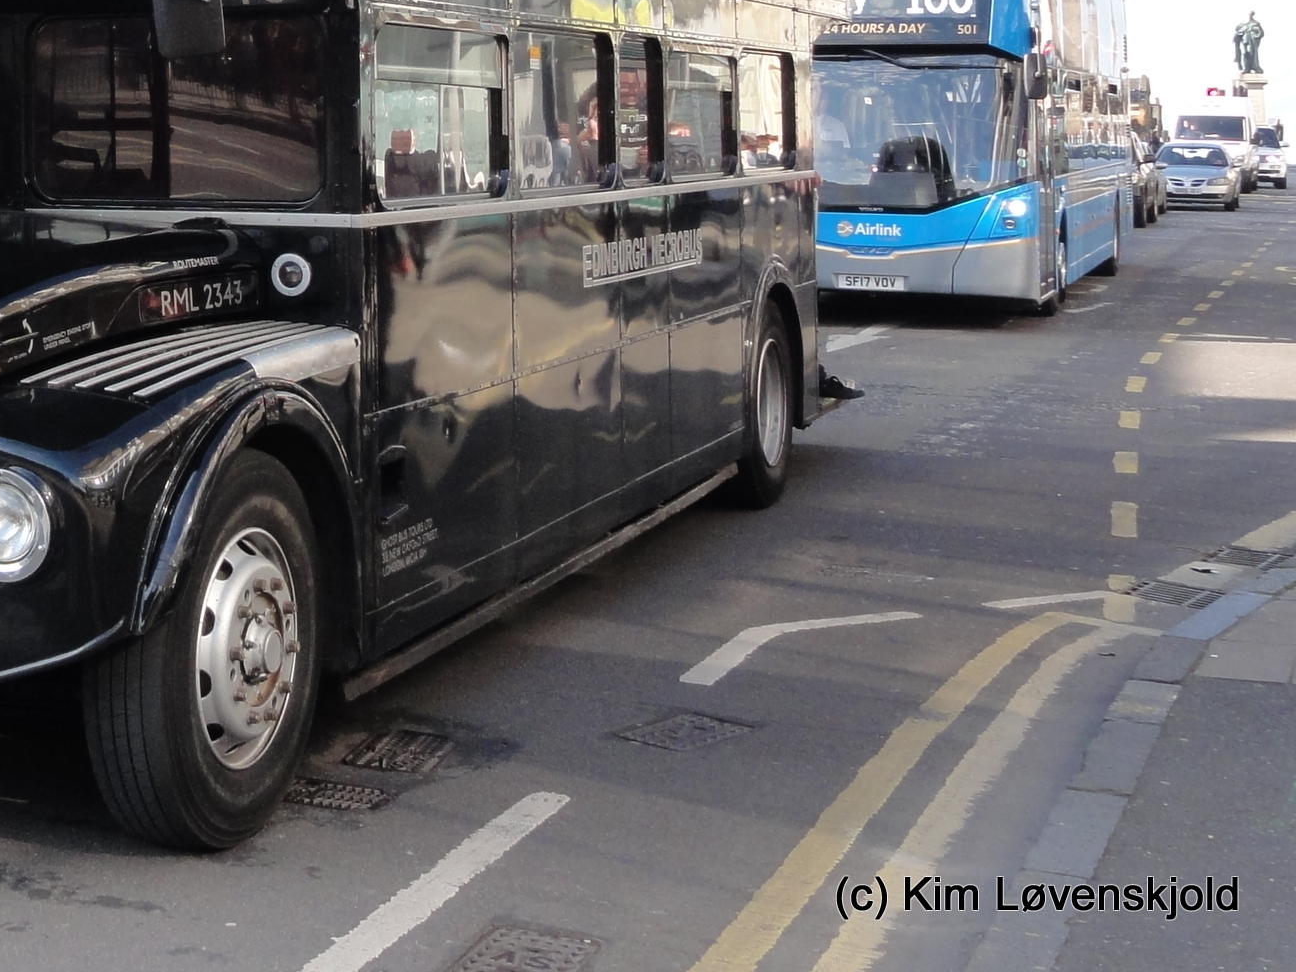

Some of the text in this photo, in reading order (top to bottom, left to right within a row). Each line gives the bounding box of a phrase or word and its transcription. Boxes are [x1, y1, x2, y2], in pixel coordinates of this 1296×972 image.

[841, 24, 886, 34] HOURS
[886, 23, 896, 34] A
[899, 23, 926, 34] DAY
[957, 24, 977, 35] 501
[854, 222, 902, 237] Airlink
[172, 256, 219, 269] ROUTEMASTER
[582, 228, 703, 288] EDINBURGH NECROBUS
[845, 276, 870, 287] SF17
[160, 279, 243, 316] RML 2343
